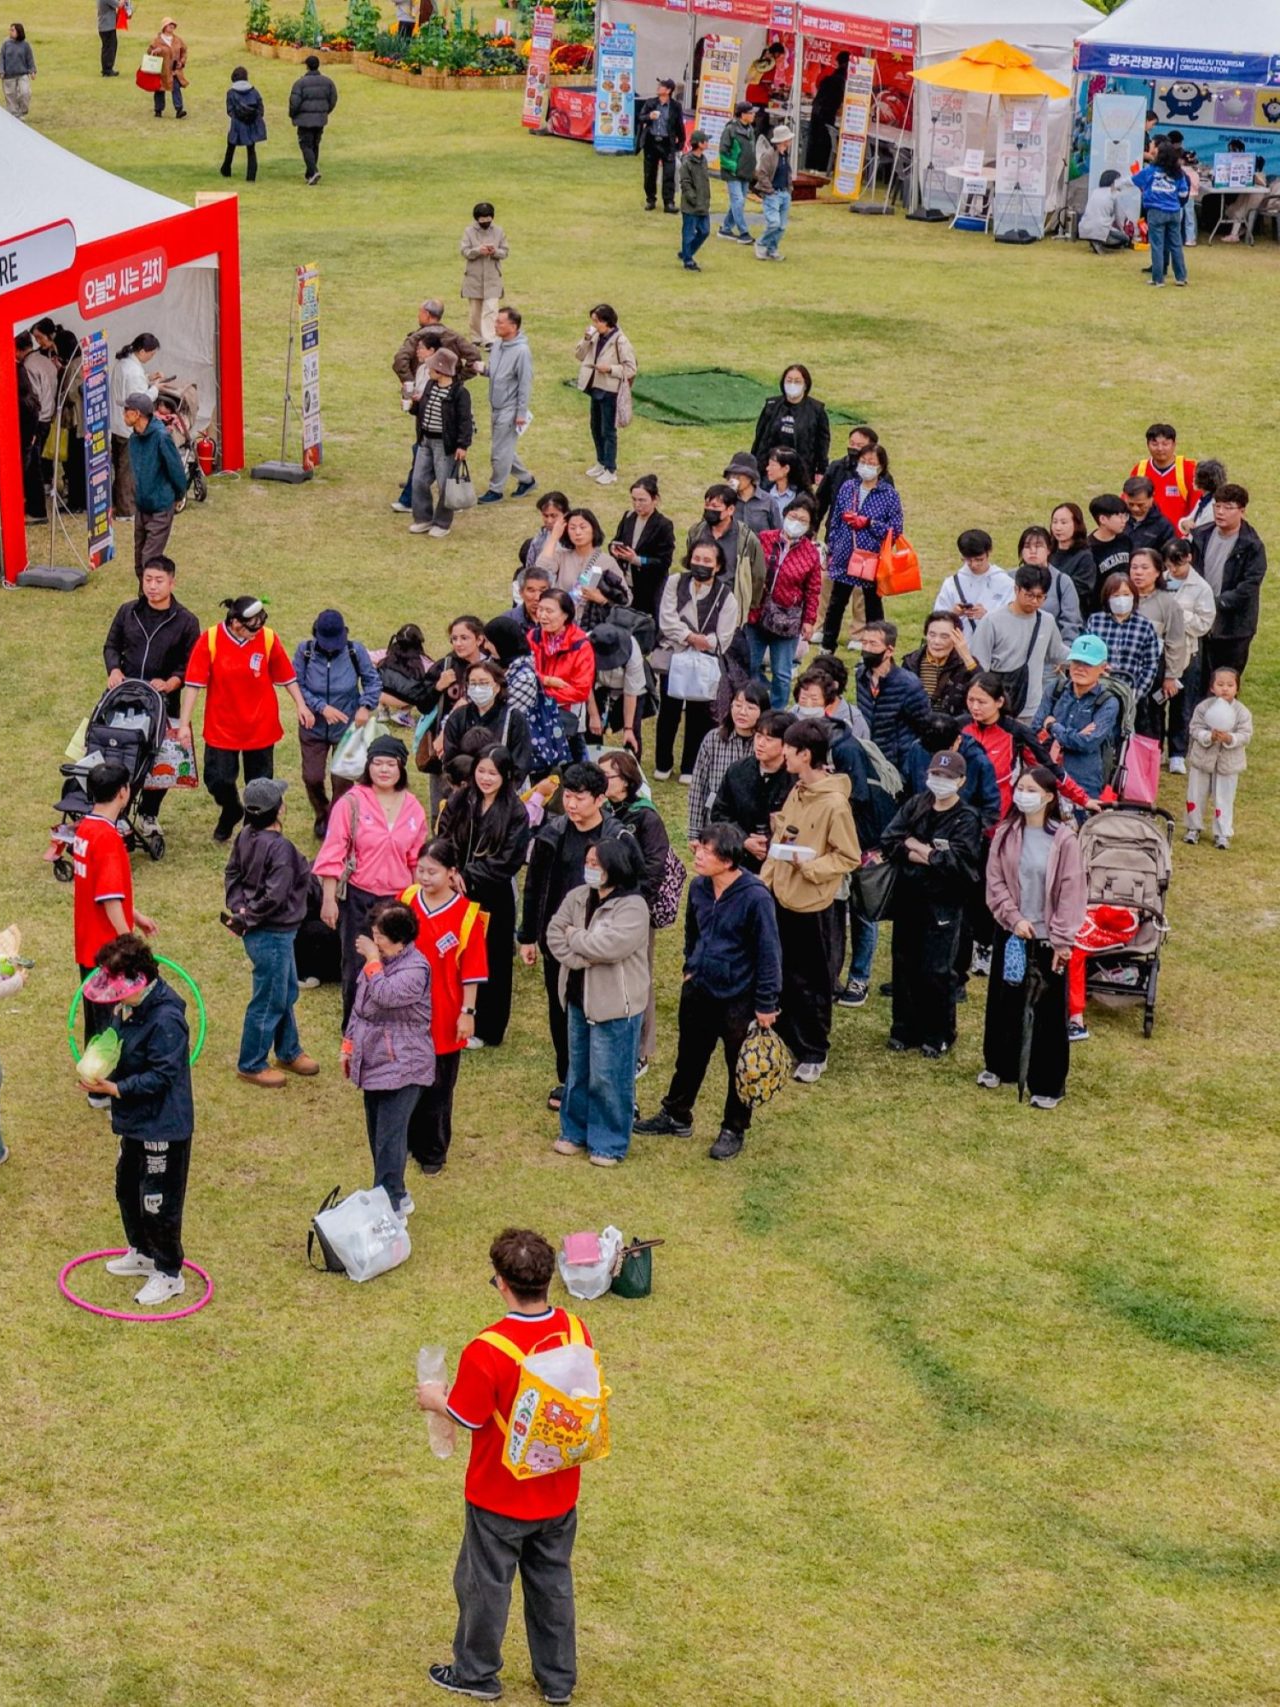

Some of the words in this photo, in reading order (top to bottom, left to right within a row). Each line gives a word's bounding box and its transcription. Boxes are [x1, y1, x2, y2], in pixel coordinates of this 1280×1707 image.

[1108, 53, 1175, 70] 광주관광공사
[1180, 57, 1213, 66] GWANGJU
[1214, 59, 1245, 68] TOURISM
[1180, 64, 1230, 74] ORGANIZATION
[84, 281, 116, 310] 오늘만
[118, 266, 140, 296] 사는
[141, 256, 163, 287] 김치
